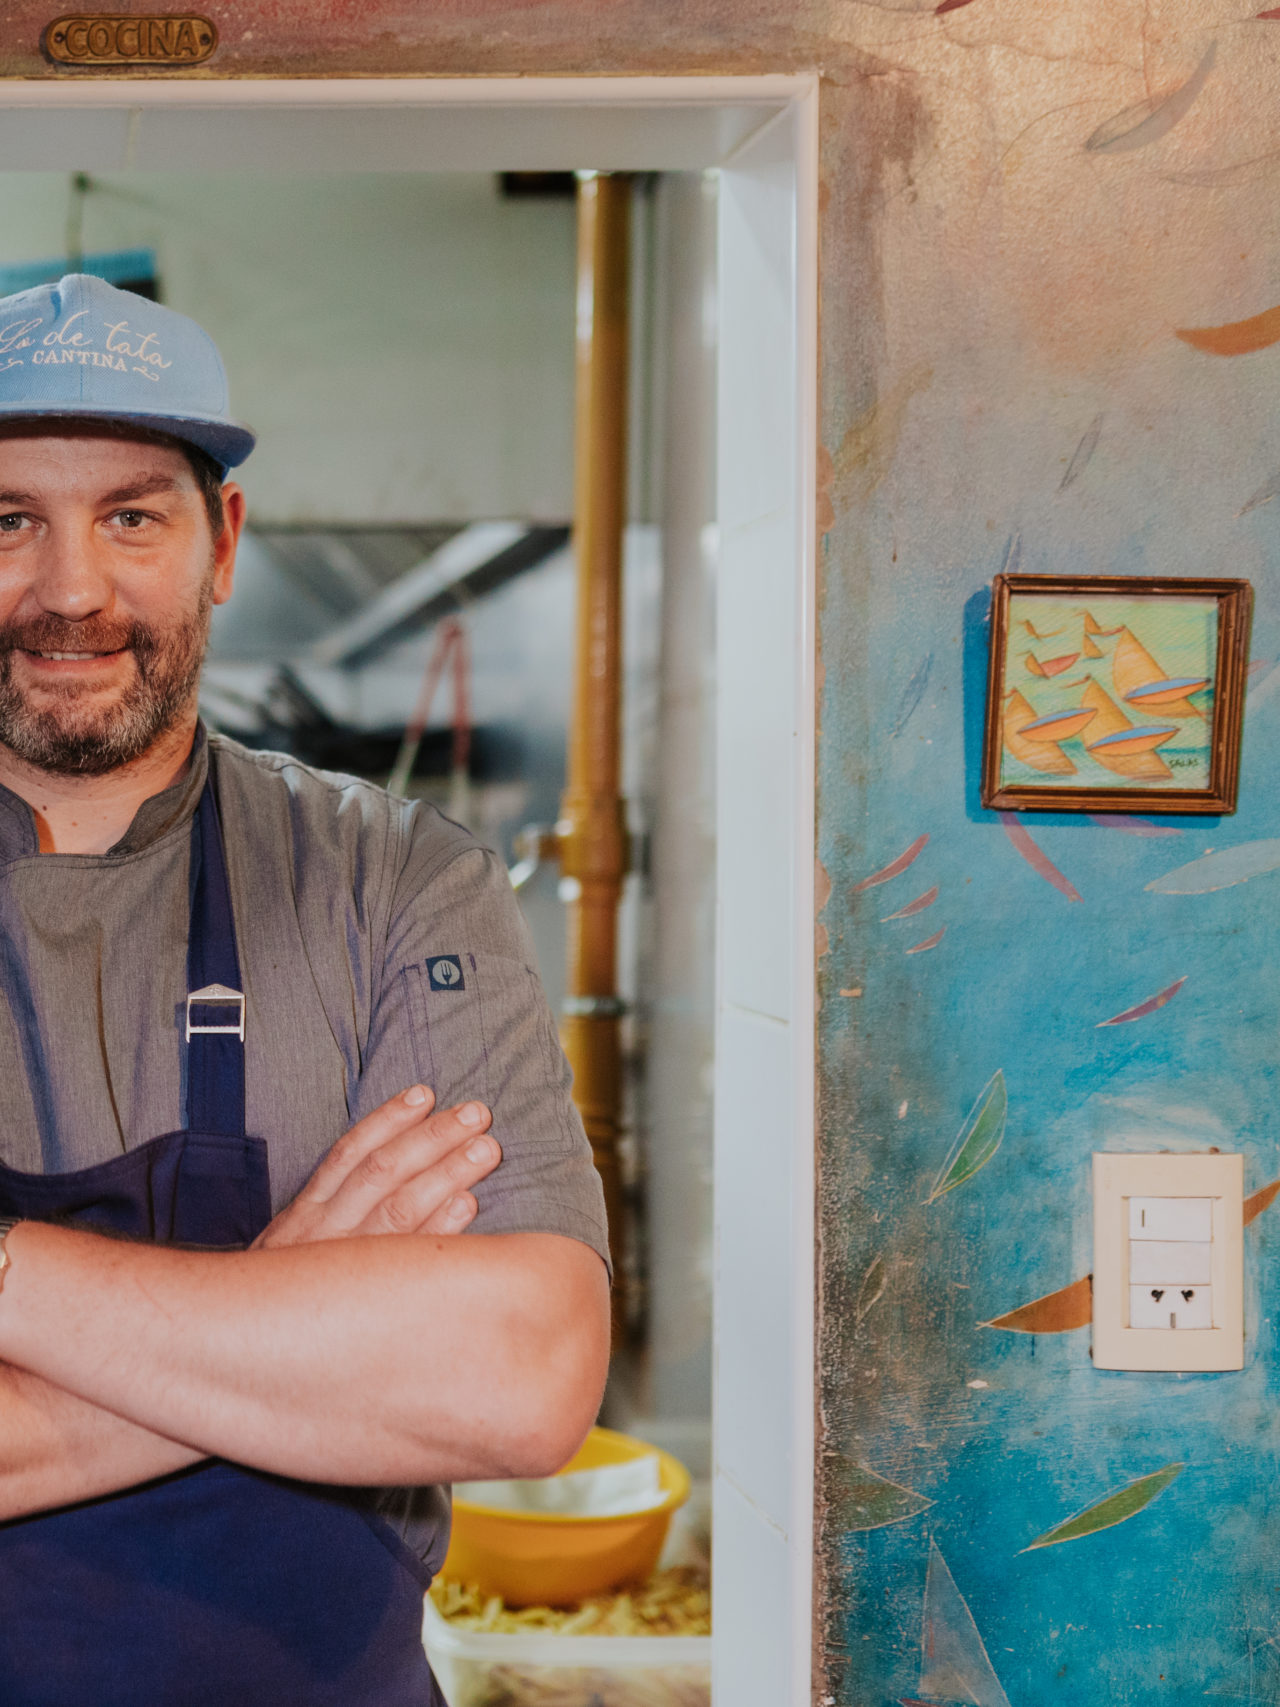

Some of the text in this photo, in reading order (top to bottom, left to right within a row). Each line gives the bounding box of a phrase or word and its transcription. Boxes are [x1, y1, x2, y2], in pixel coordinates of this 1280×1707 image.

[66, 21, 199, 57] COCINA
[43, 311, 93, 346] de
[104, 321, 172, 370] tata
[32, 349, 128, 373] CANTINA
